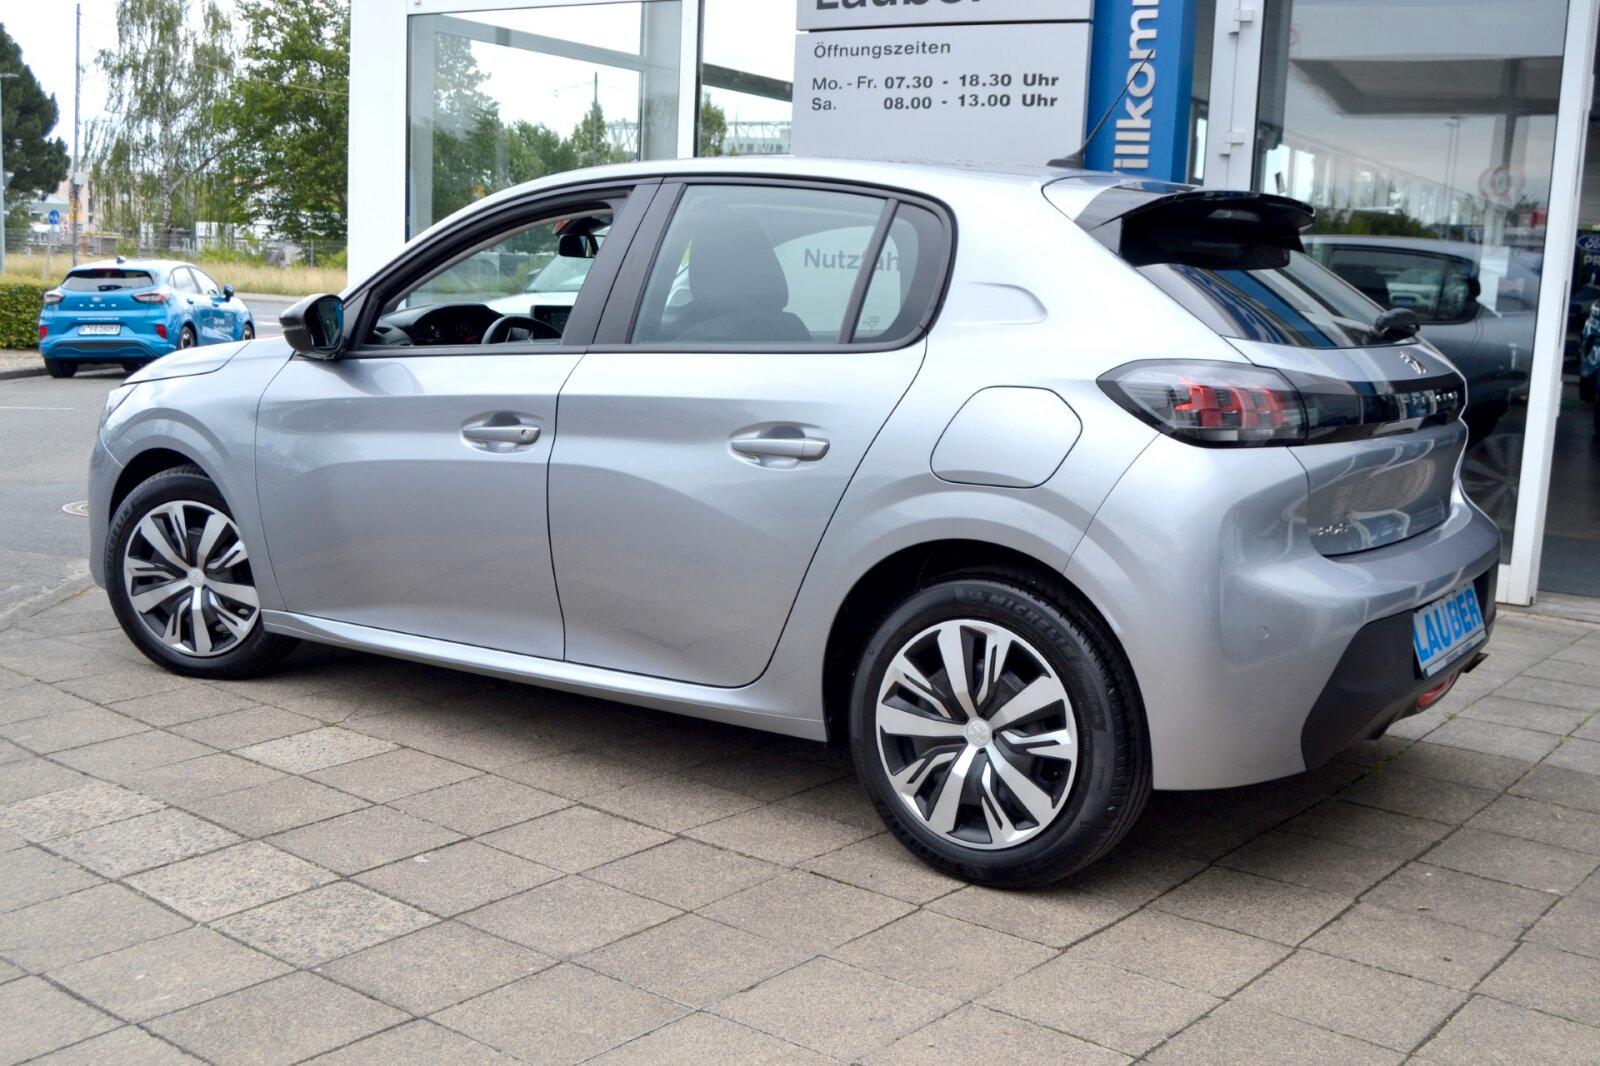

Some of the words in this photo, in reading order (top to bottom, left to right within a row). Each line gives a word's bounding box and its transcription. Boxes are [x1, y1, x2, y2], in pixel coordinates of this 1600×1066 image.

[813, 41, 951, 59] Öffnungszeiten
[856, 75, 877, 89] Fr.
[884, 76, 933, 89] 07.30
[959, 74, 1012, 87] 18.30
[1023, 73, 1059, 86] Uhr
[1113, 0, 1160, 172] illkom
[811, 97, 836, 111] Sa.
[883, 96, 932, 109] 08.00
[958, 94, 1011, 107] 13.00
[1022, 94, 1058, 107] Uhr
[1413, 588, 1482, 662] LAUBER
